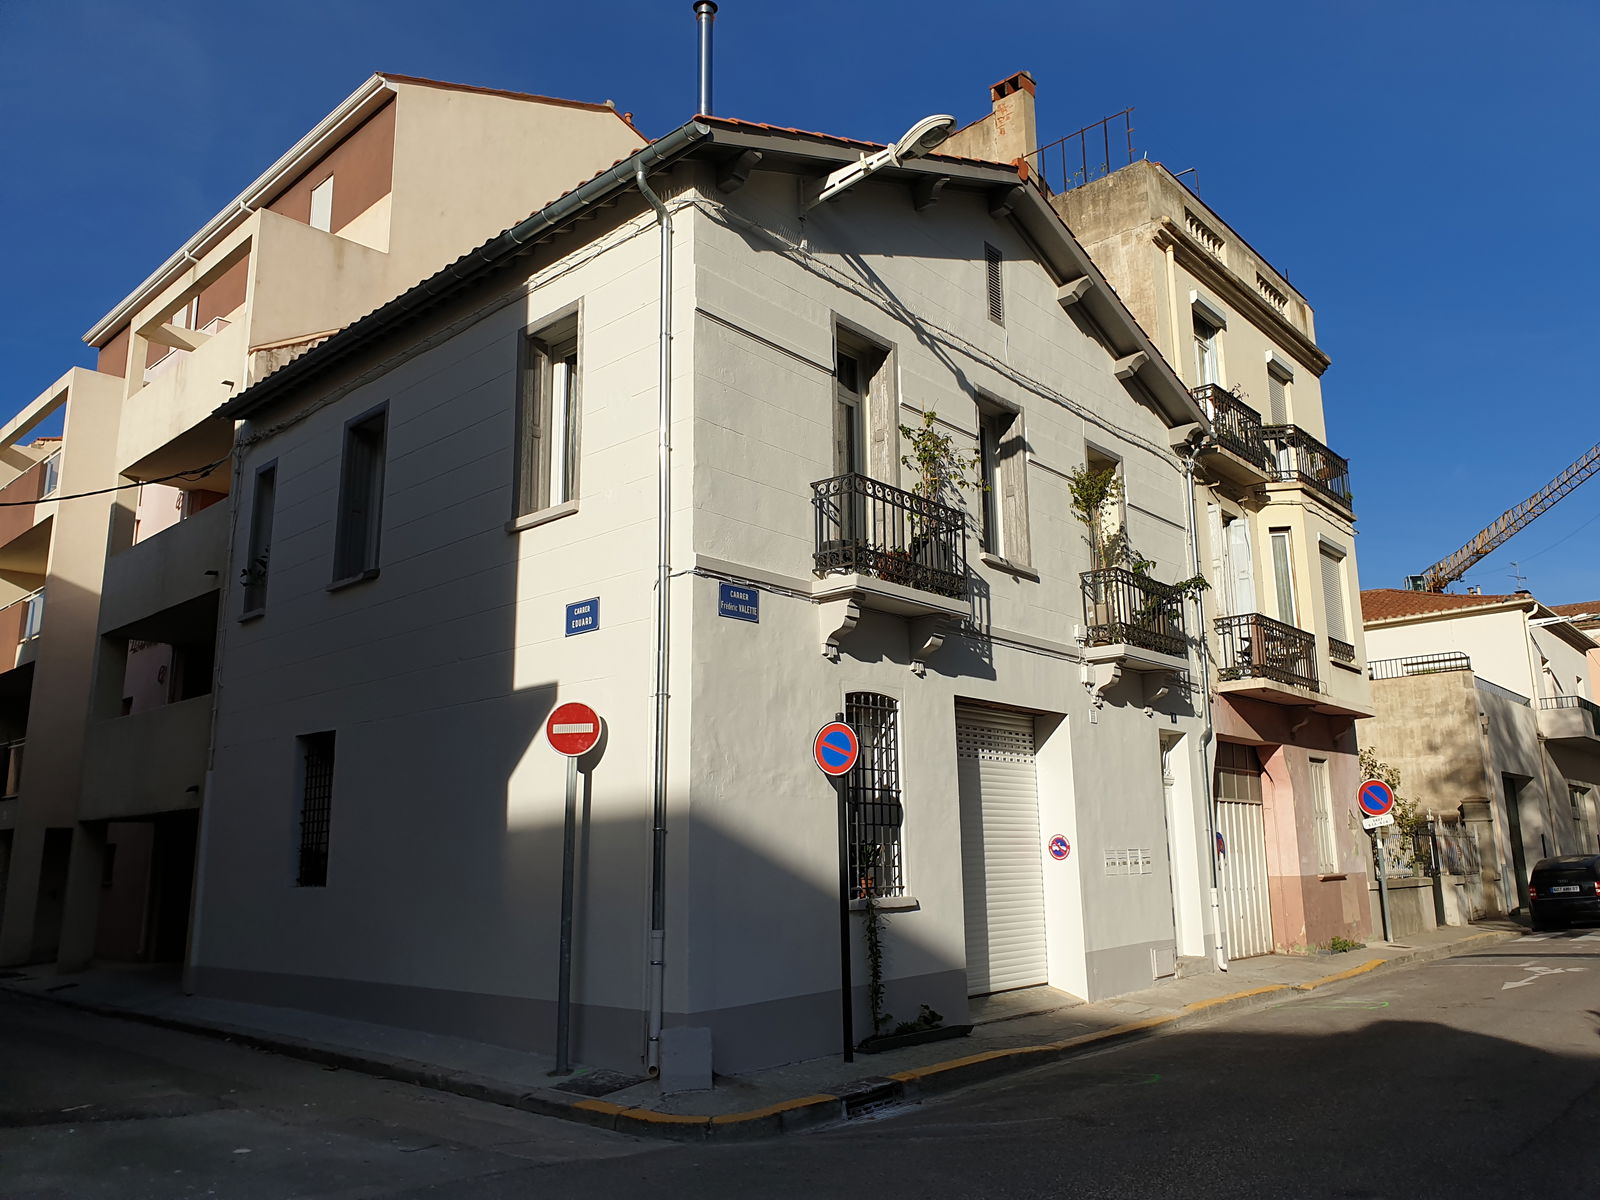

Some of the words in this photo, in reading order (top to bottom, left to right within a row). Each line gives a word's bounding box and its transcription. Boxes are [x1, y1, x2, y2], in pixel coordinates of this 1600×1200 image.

[730, 590, 749, 601] CARRER
[574, 605, 591, 616] CARRER
[738, 603, 758, 616] VALETTE
[572, 616, 593, 629] EDUARD
